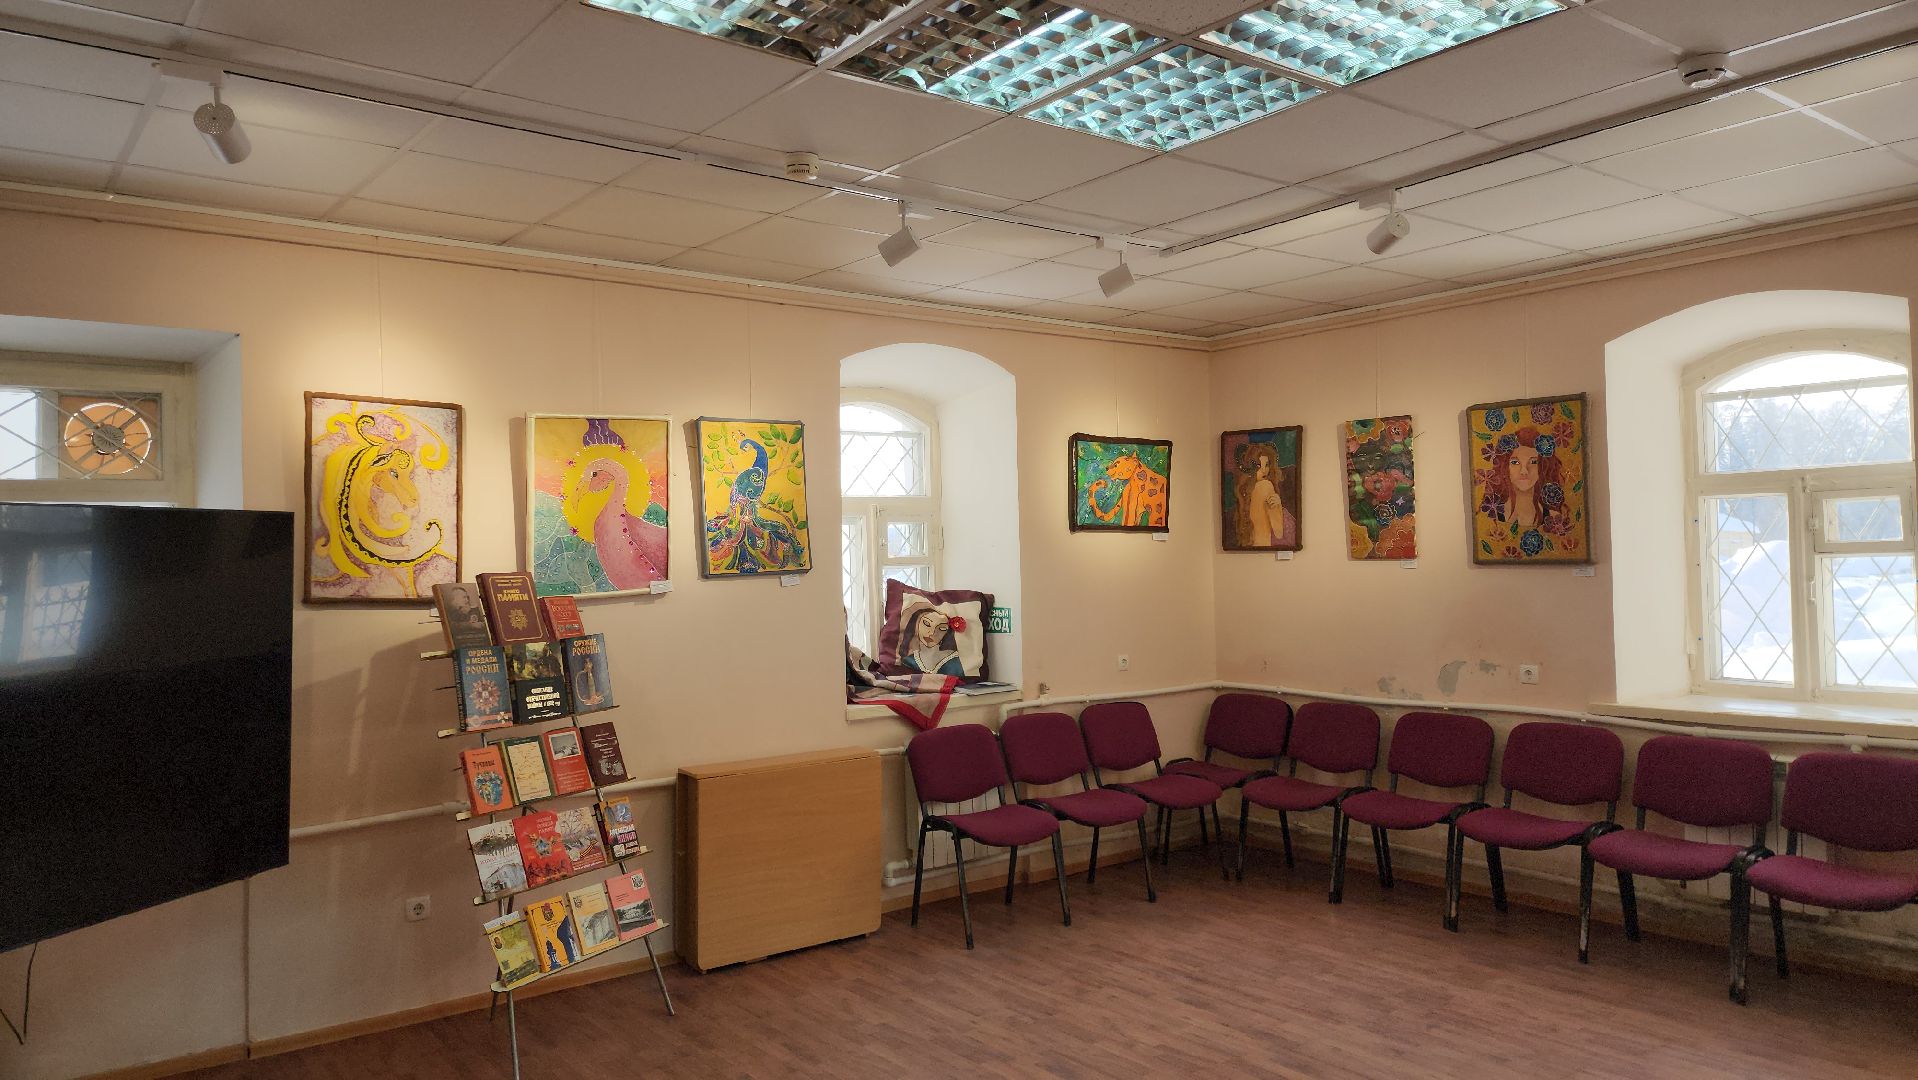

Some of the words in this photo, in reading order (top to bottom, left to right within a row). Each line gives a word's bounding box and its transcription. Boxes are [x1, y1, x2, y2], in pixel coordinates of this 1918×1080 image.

[988, 617, 1009, 633] ХОД
[572, 645, 601, 656] РОССИИ
[465, 664, 499, 673] РОССИИ
